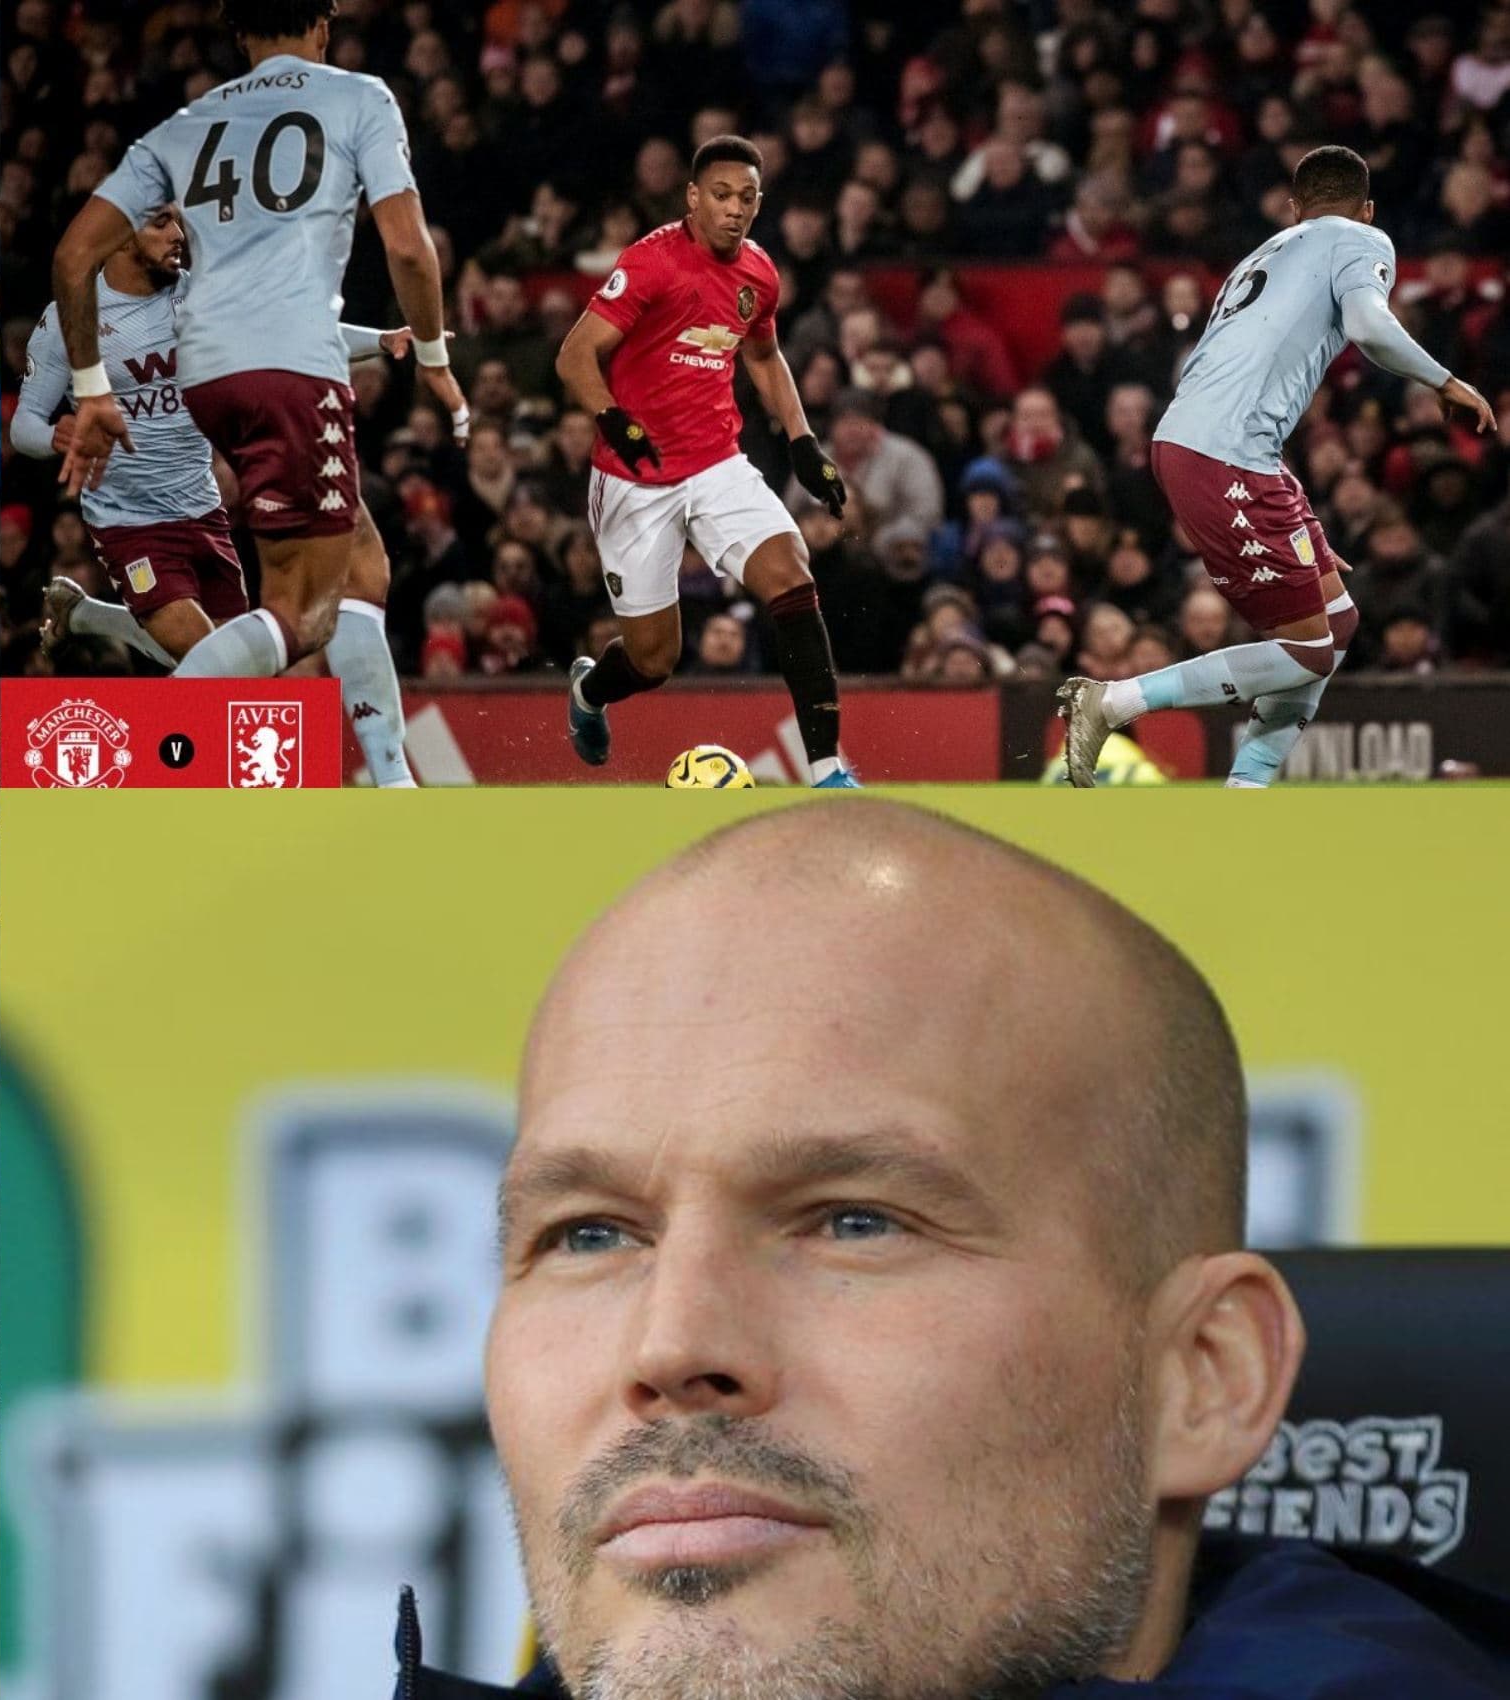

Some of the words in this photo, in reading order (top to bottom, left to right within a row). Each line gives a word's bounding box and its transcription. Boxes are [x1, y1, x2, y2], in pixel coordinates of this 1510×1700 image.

[222, 71, 310, 100] MINGS
[183, 110, 326, 222] 40
[670, 352, 729, 371] CHEVRO
[118, 383, 180, 420] W8
